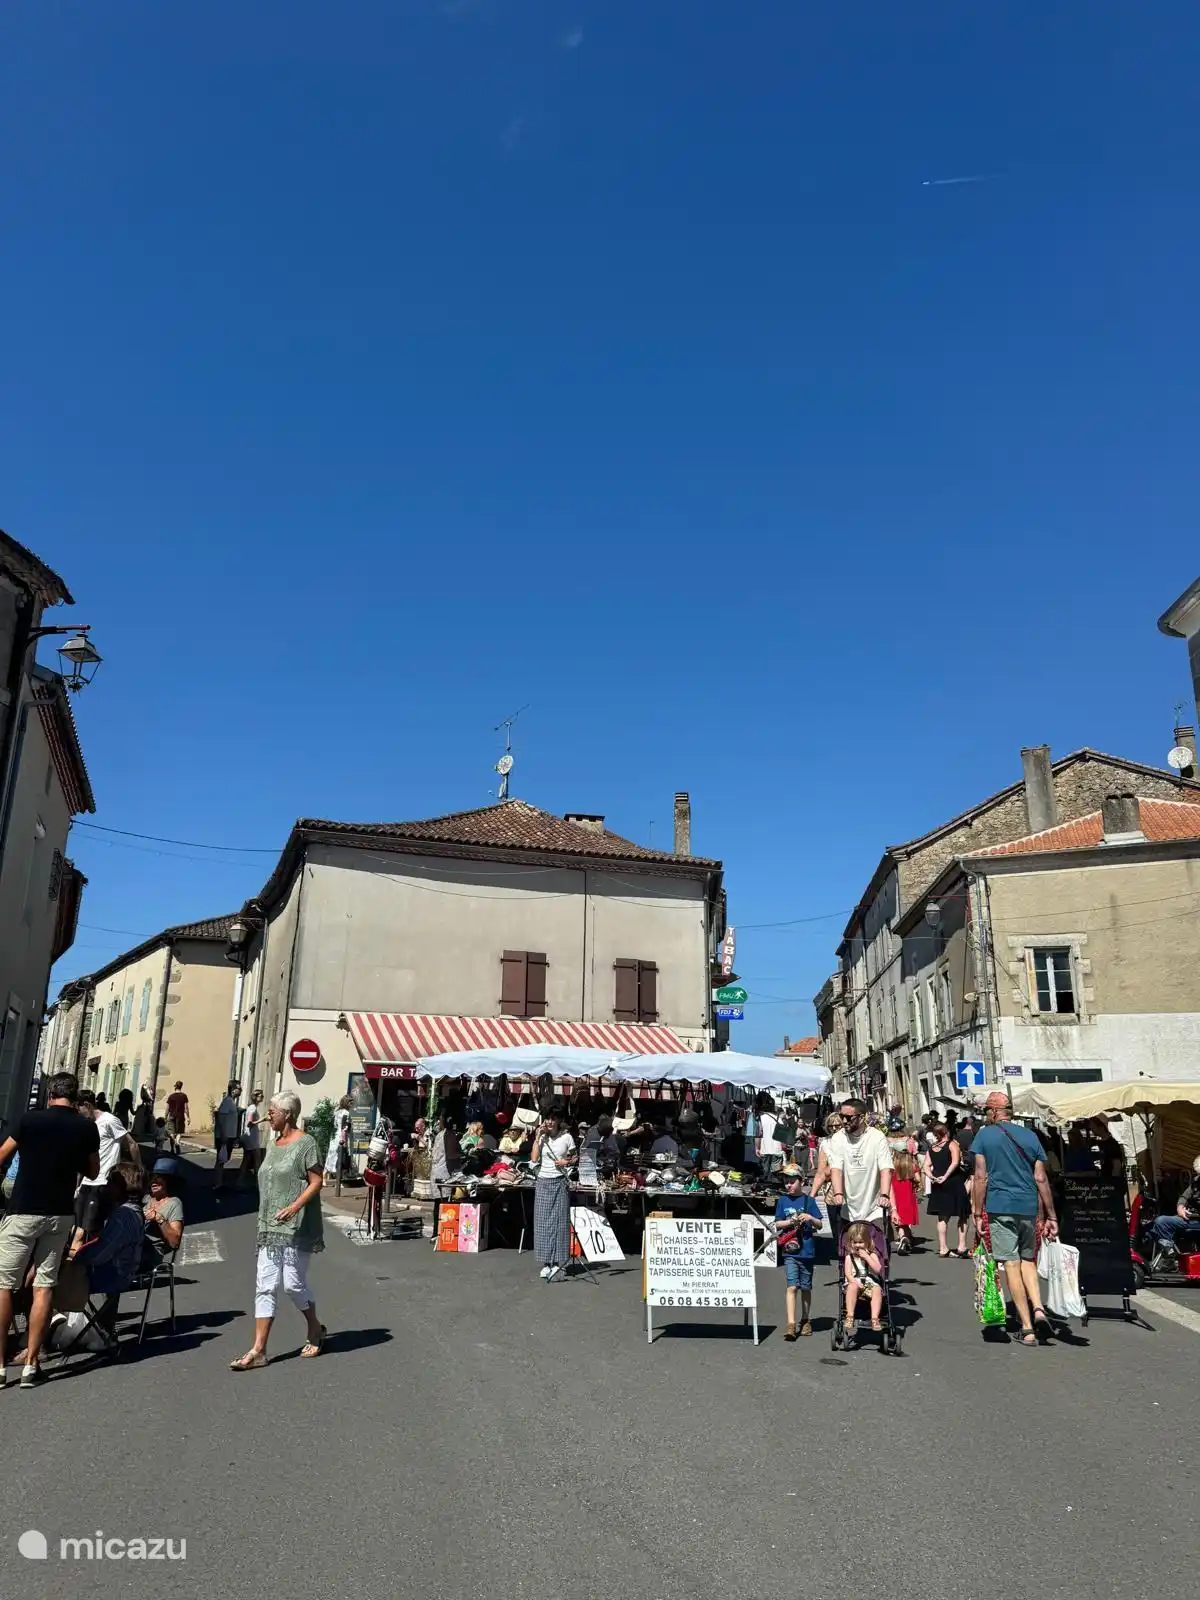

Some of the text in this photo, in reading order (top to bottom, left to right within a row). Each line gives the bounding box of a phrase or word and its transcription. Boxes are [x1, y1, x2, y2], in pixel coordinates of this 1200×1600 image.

[723, 927, 735, 974] TABAC
[381, 1067, 403, 1076] BAR
[676, 1221, 721, 1233] VENTE
[590, 1230, 605, 1254] 10
[649, 1268, 752, 1277] TAPISSERIE SUR FAUTEUIL
[660, 1296, 744, 1307] 06 08 45 38 12
